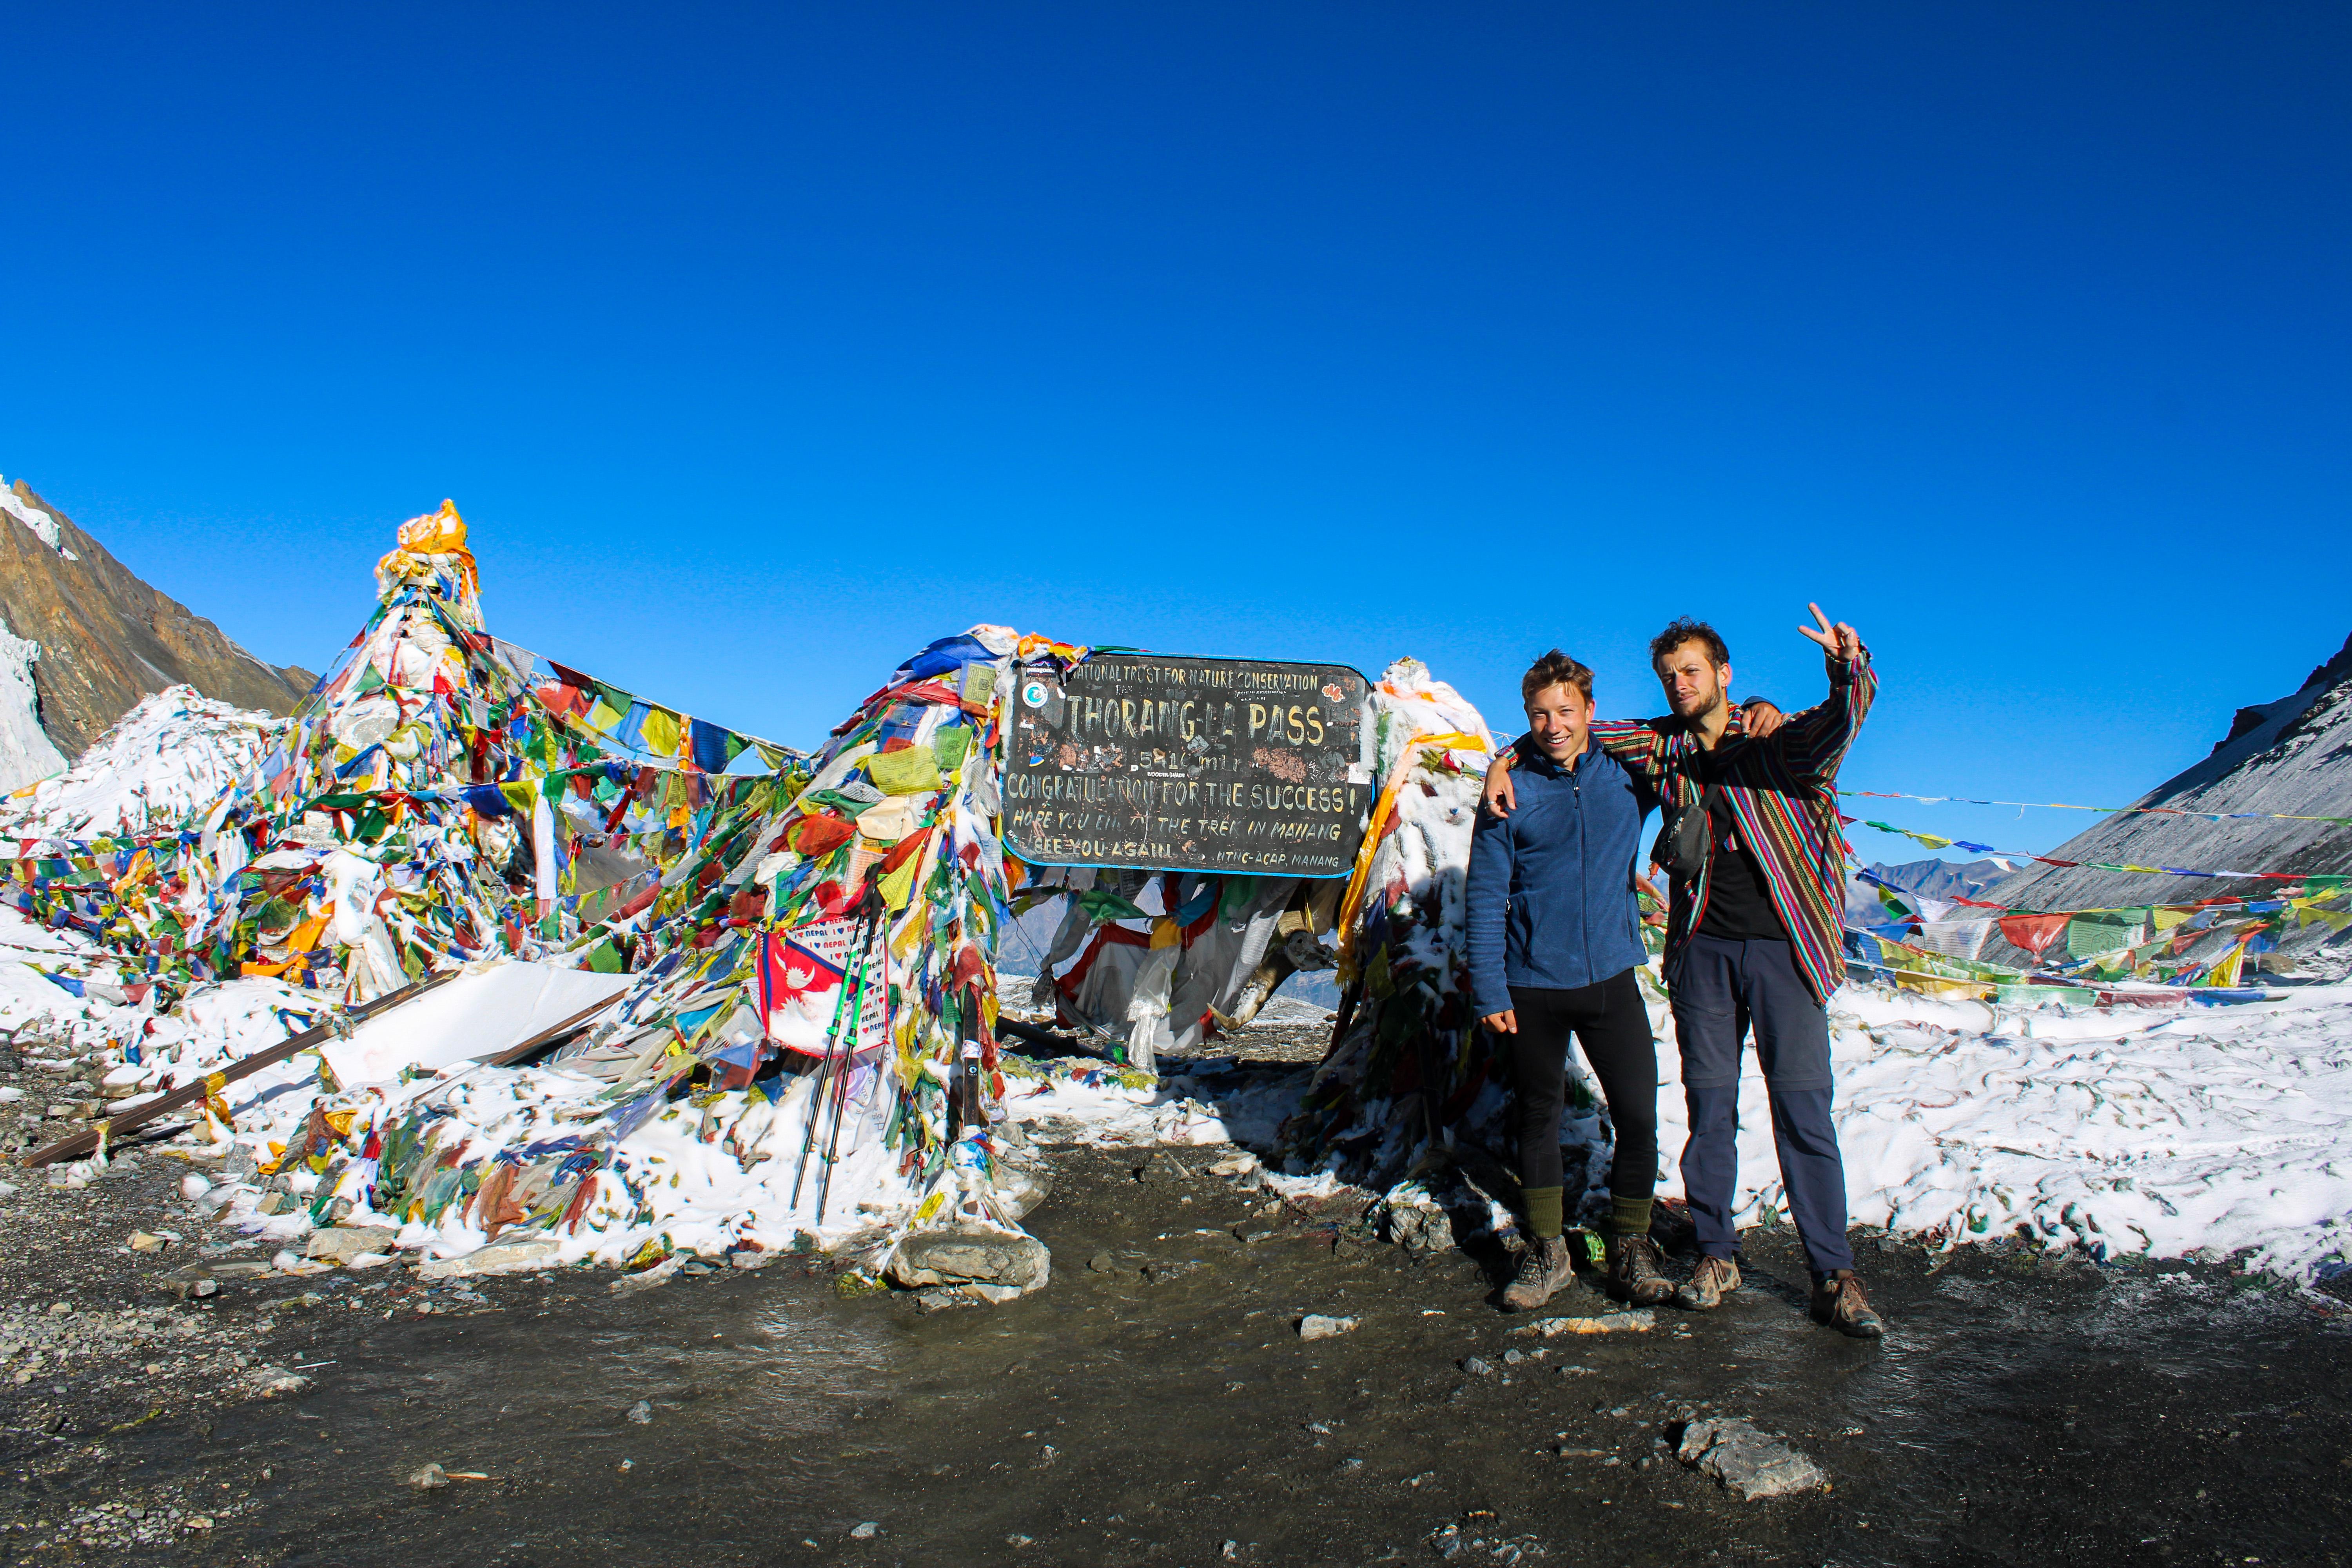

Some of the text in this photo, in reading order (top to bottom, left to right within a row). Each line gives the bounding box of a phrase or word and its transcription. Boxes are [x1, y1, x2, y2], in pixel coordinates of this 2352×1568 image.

[1123, 666, 1161, 684] TRUST
[1164, 667, 1187, 687] FOR
[1190, 668, 1234, 689] NATURE
[1237, 671, 1318, 691] CONSERVATION
[1248, 704, 1324, 746] PASS
[1163, 780, 1201, 807] FOR
[1206, 782, 1244, 808] THE
[1013, 809, 1053, 829] HOPE
[1059, 812, 1089, 830] YOU
[1158, 817, 1191, 835] THE
[1198, 819, 1241, 837] TREK
[1247, 820, 1266, 837] IN
[1270, 821, 1341, 841] MANANG
[1034, 836, 1171, 859] SEE YOU AGAIN
[1292, 854, 1339, 867] MANANG
[824, 940, 846, 948] NEPAL
[862, 1011, 879, 1023] NEPAL
